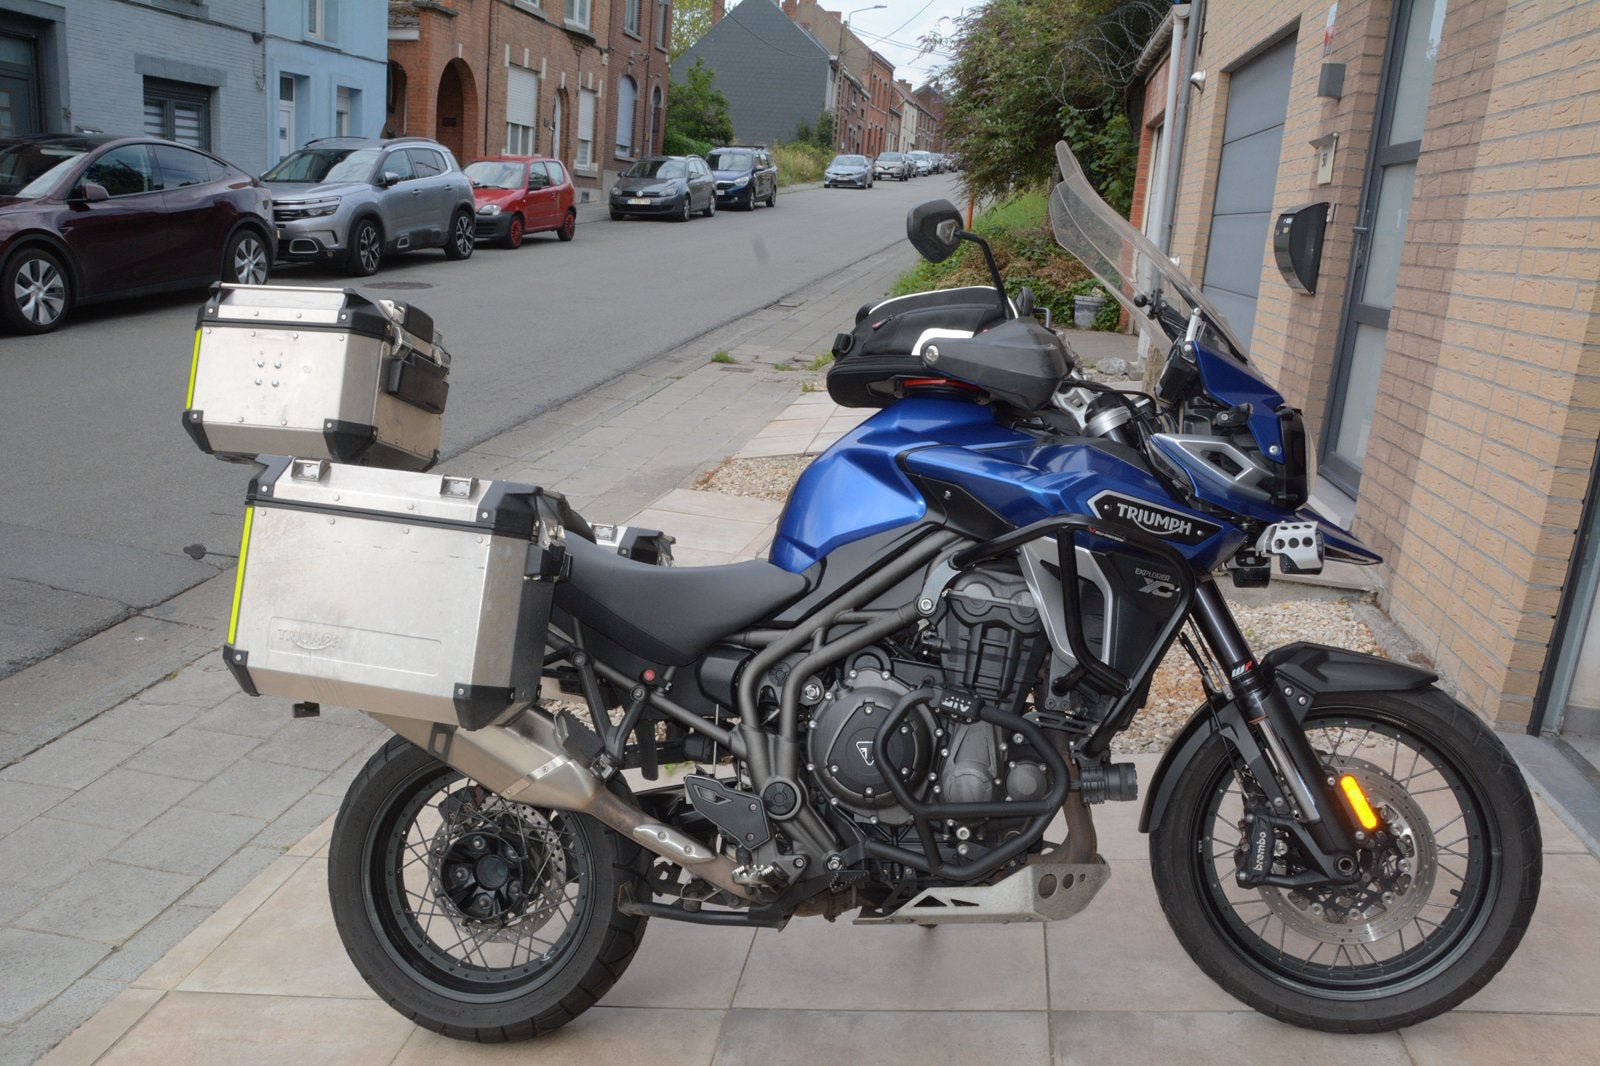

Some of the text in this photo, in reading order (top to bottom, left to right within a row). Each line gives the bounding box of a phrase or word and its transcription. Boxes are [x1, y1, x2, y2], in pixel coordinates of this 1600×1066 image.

[1117, 502, 1193, 536] TRIUMPH
[1135, 567, 1171, 582] EXPLORER
[1138, 577, 1180, 598] XC
[277, 628, 344, 650] TRIUMPH
[1253, 831, 1267, 871] brembo
